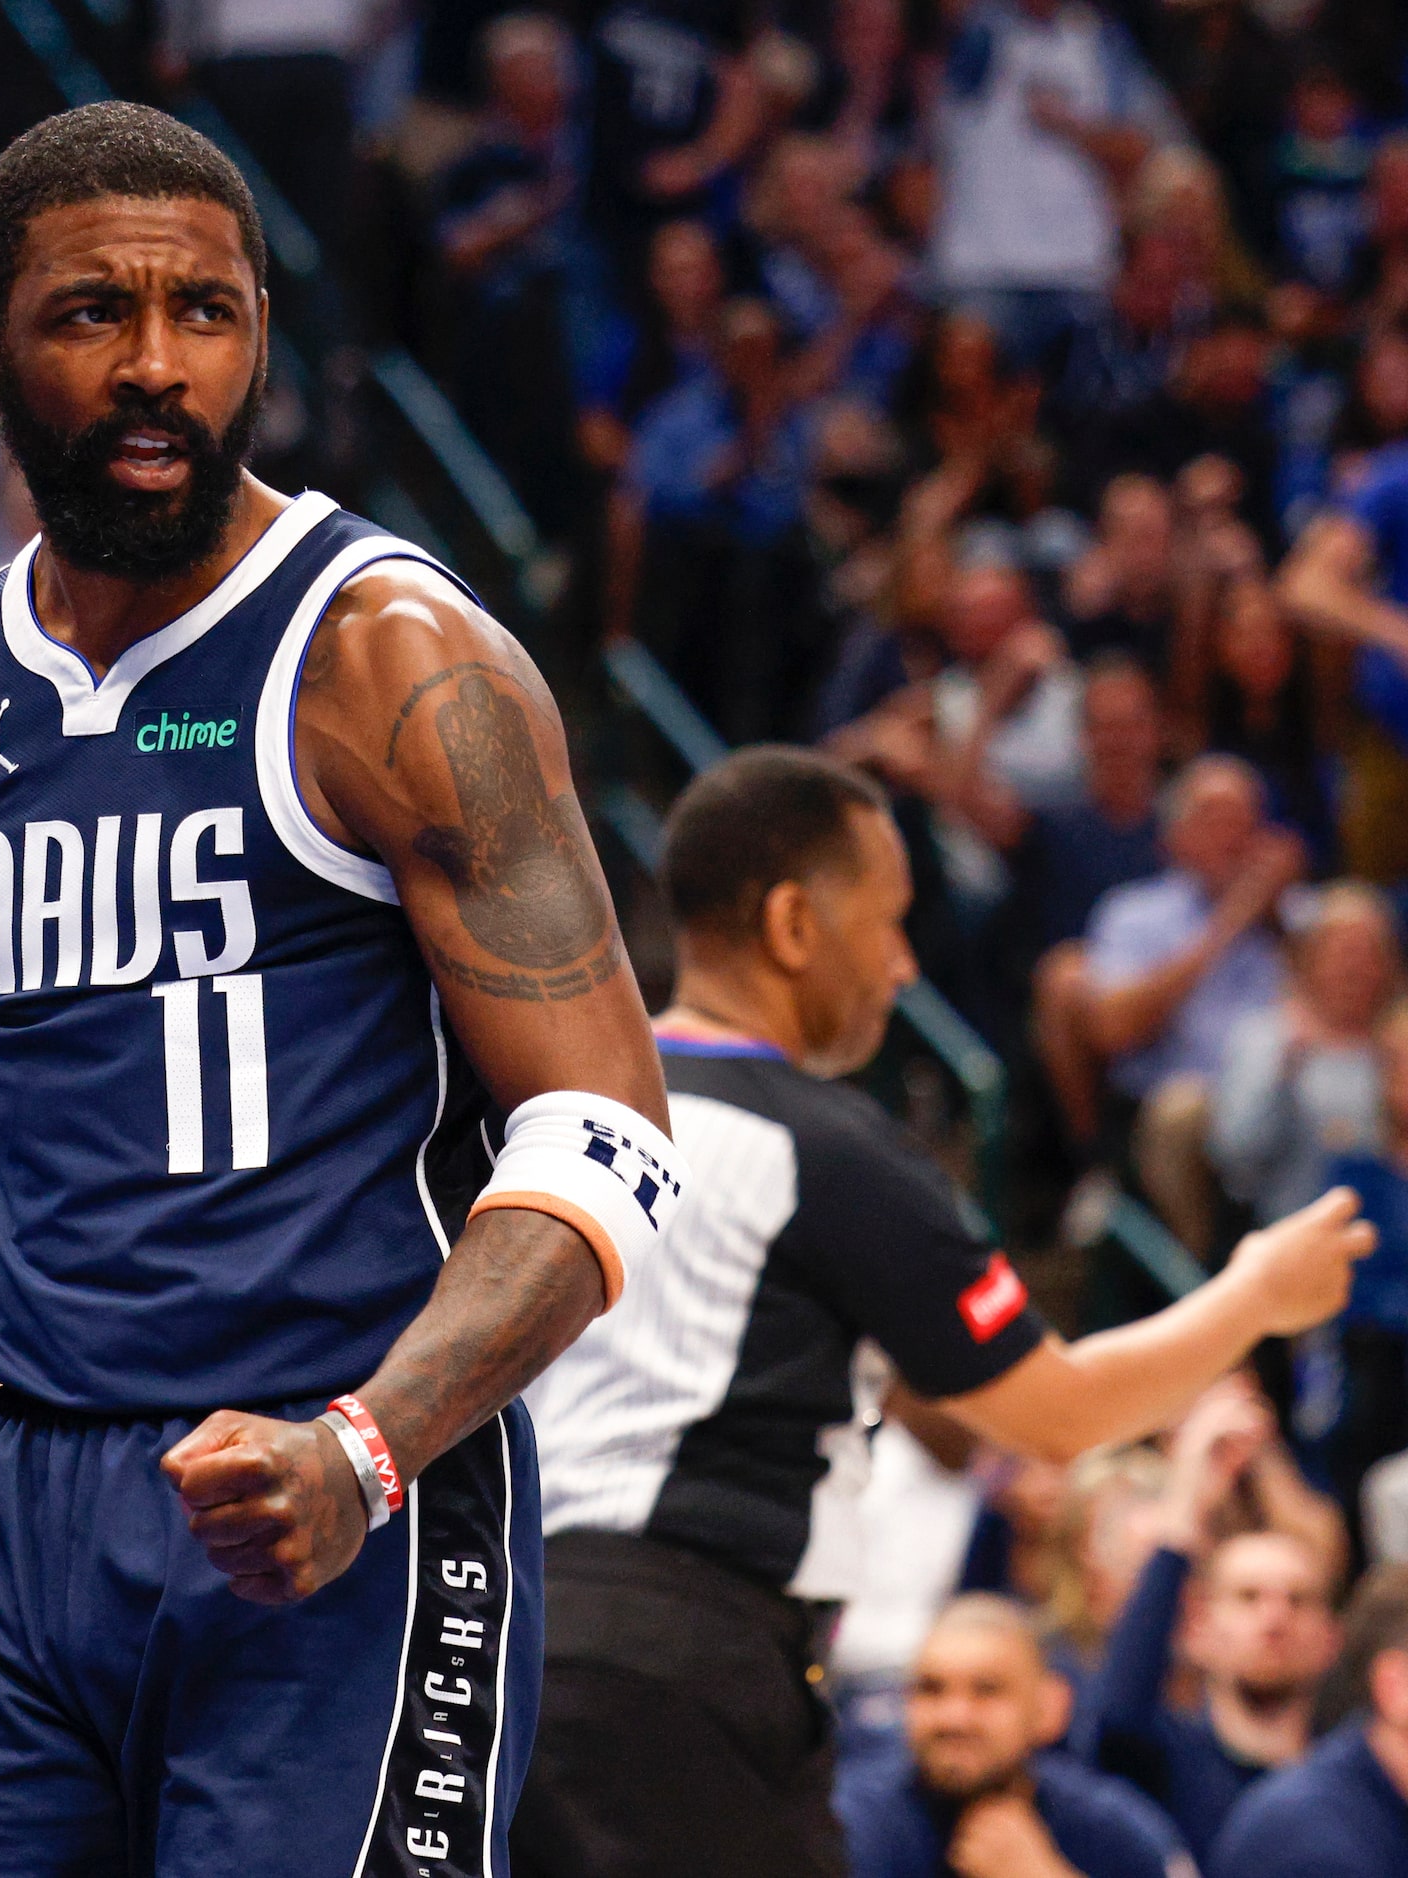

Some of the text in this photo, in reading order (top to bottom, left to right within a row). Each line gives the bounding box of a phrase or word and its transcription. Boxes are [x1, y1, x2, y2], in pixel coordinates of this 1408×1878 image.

[137, 712, 237, 752] chime
[151, 973, 269, 1175] 11
[372, 1452, 399, 1496] KAI
